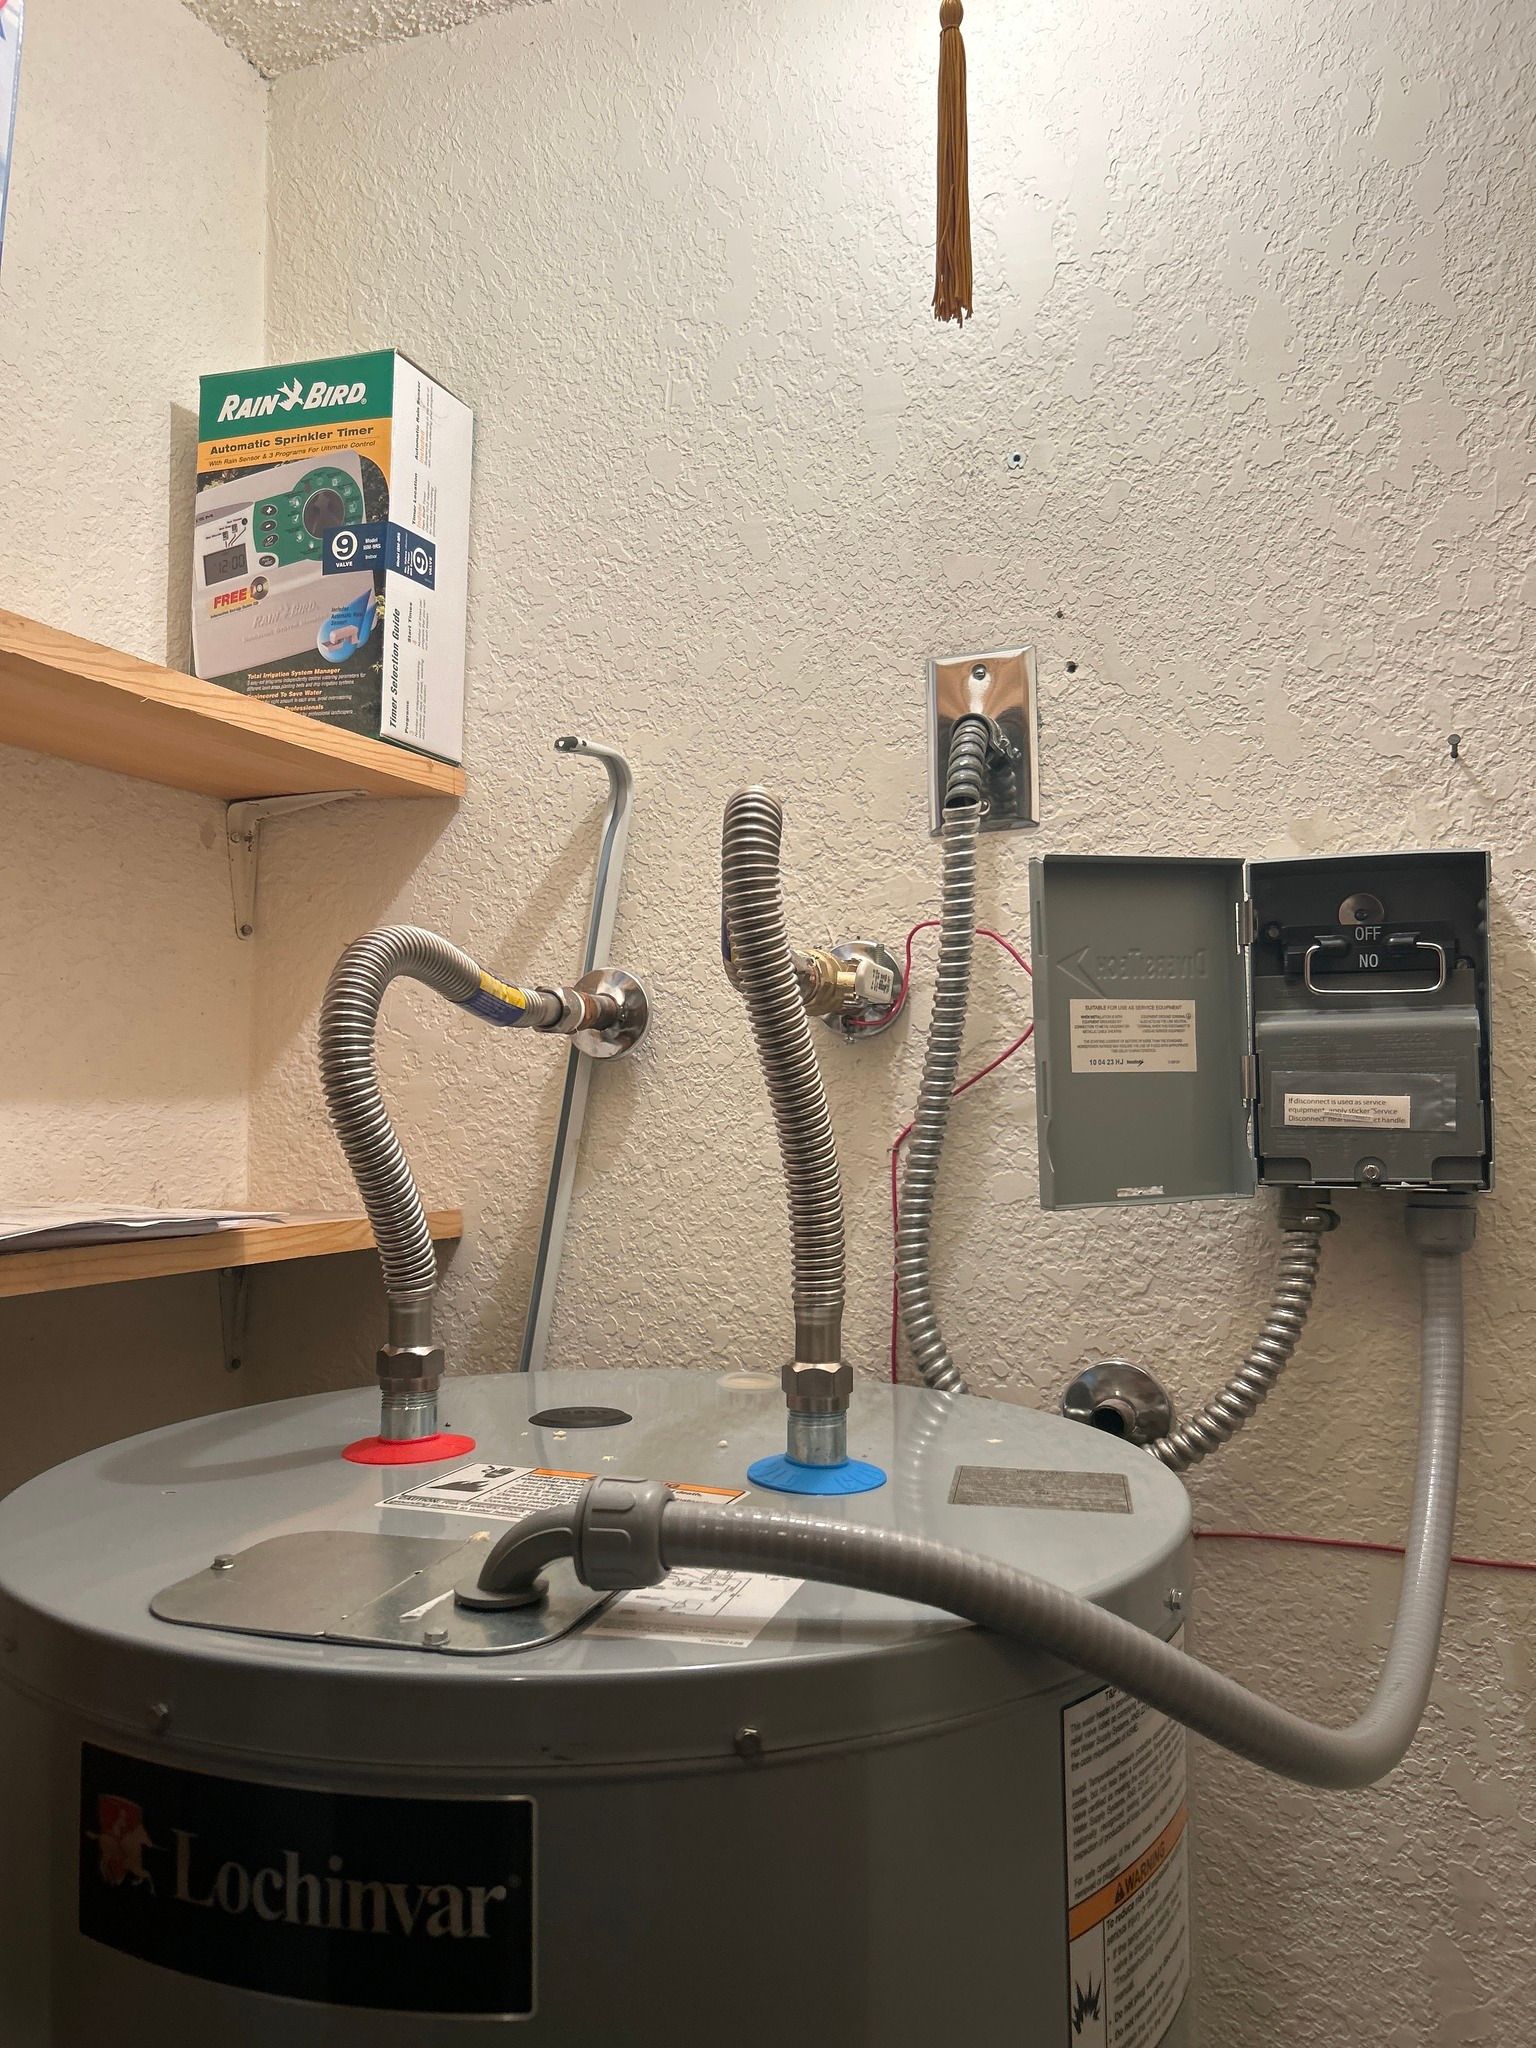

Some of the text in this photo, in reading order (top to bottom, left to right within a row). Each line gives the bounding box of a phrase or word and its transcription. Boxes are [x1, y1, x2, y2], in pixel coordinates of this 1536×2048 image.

[217, 381, 366, 422] RAIN BIRD
[210, 427, 373, 454] Automatic Sprinkler Timer
[239, 455, 260, 463] Sensor
[275, 449, 306, 460] Programs
[321, 443, 348, 451] Ultimate
[351, 440, 375, 448] Control
[336, 534, 354, 557] 9
[214, 588, 247, 609] FREE
[263, 671, 289, 679] Irrigation
[389, 608, 400, 729] Timer Selection Guide
[1355, 926, 1382, 941] OFF
[1125, 1841, 1165, 1893] WARNING
[168, 1827, 507, 1940] Lochinvar
